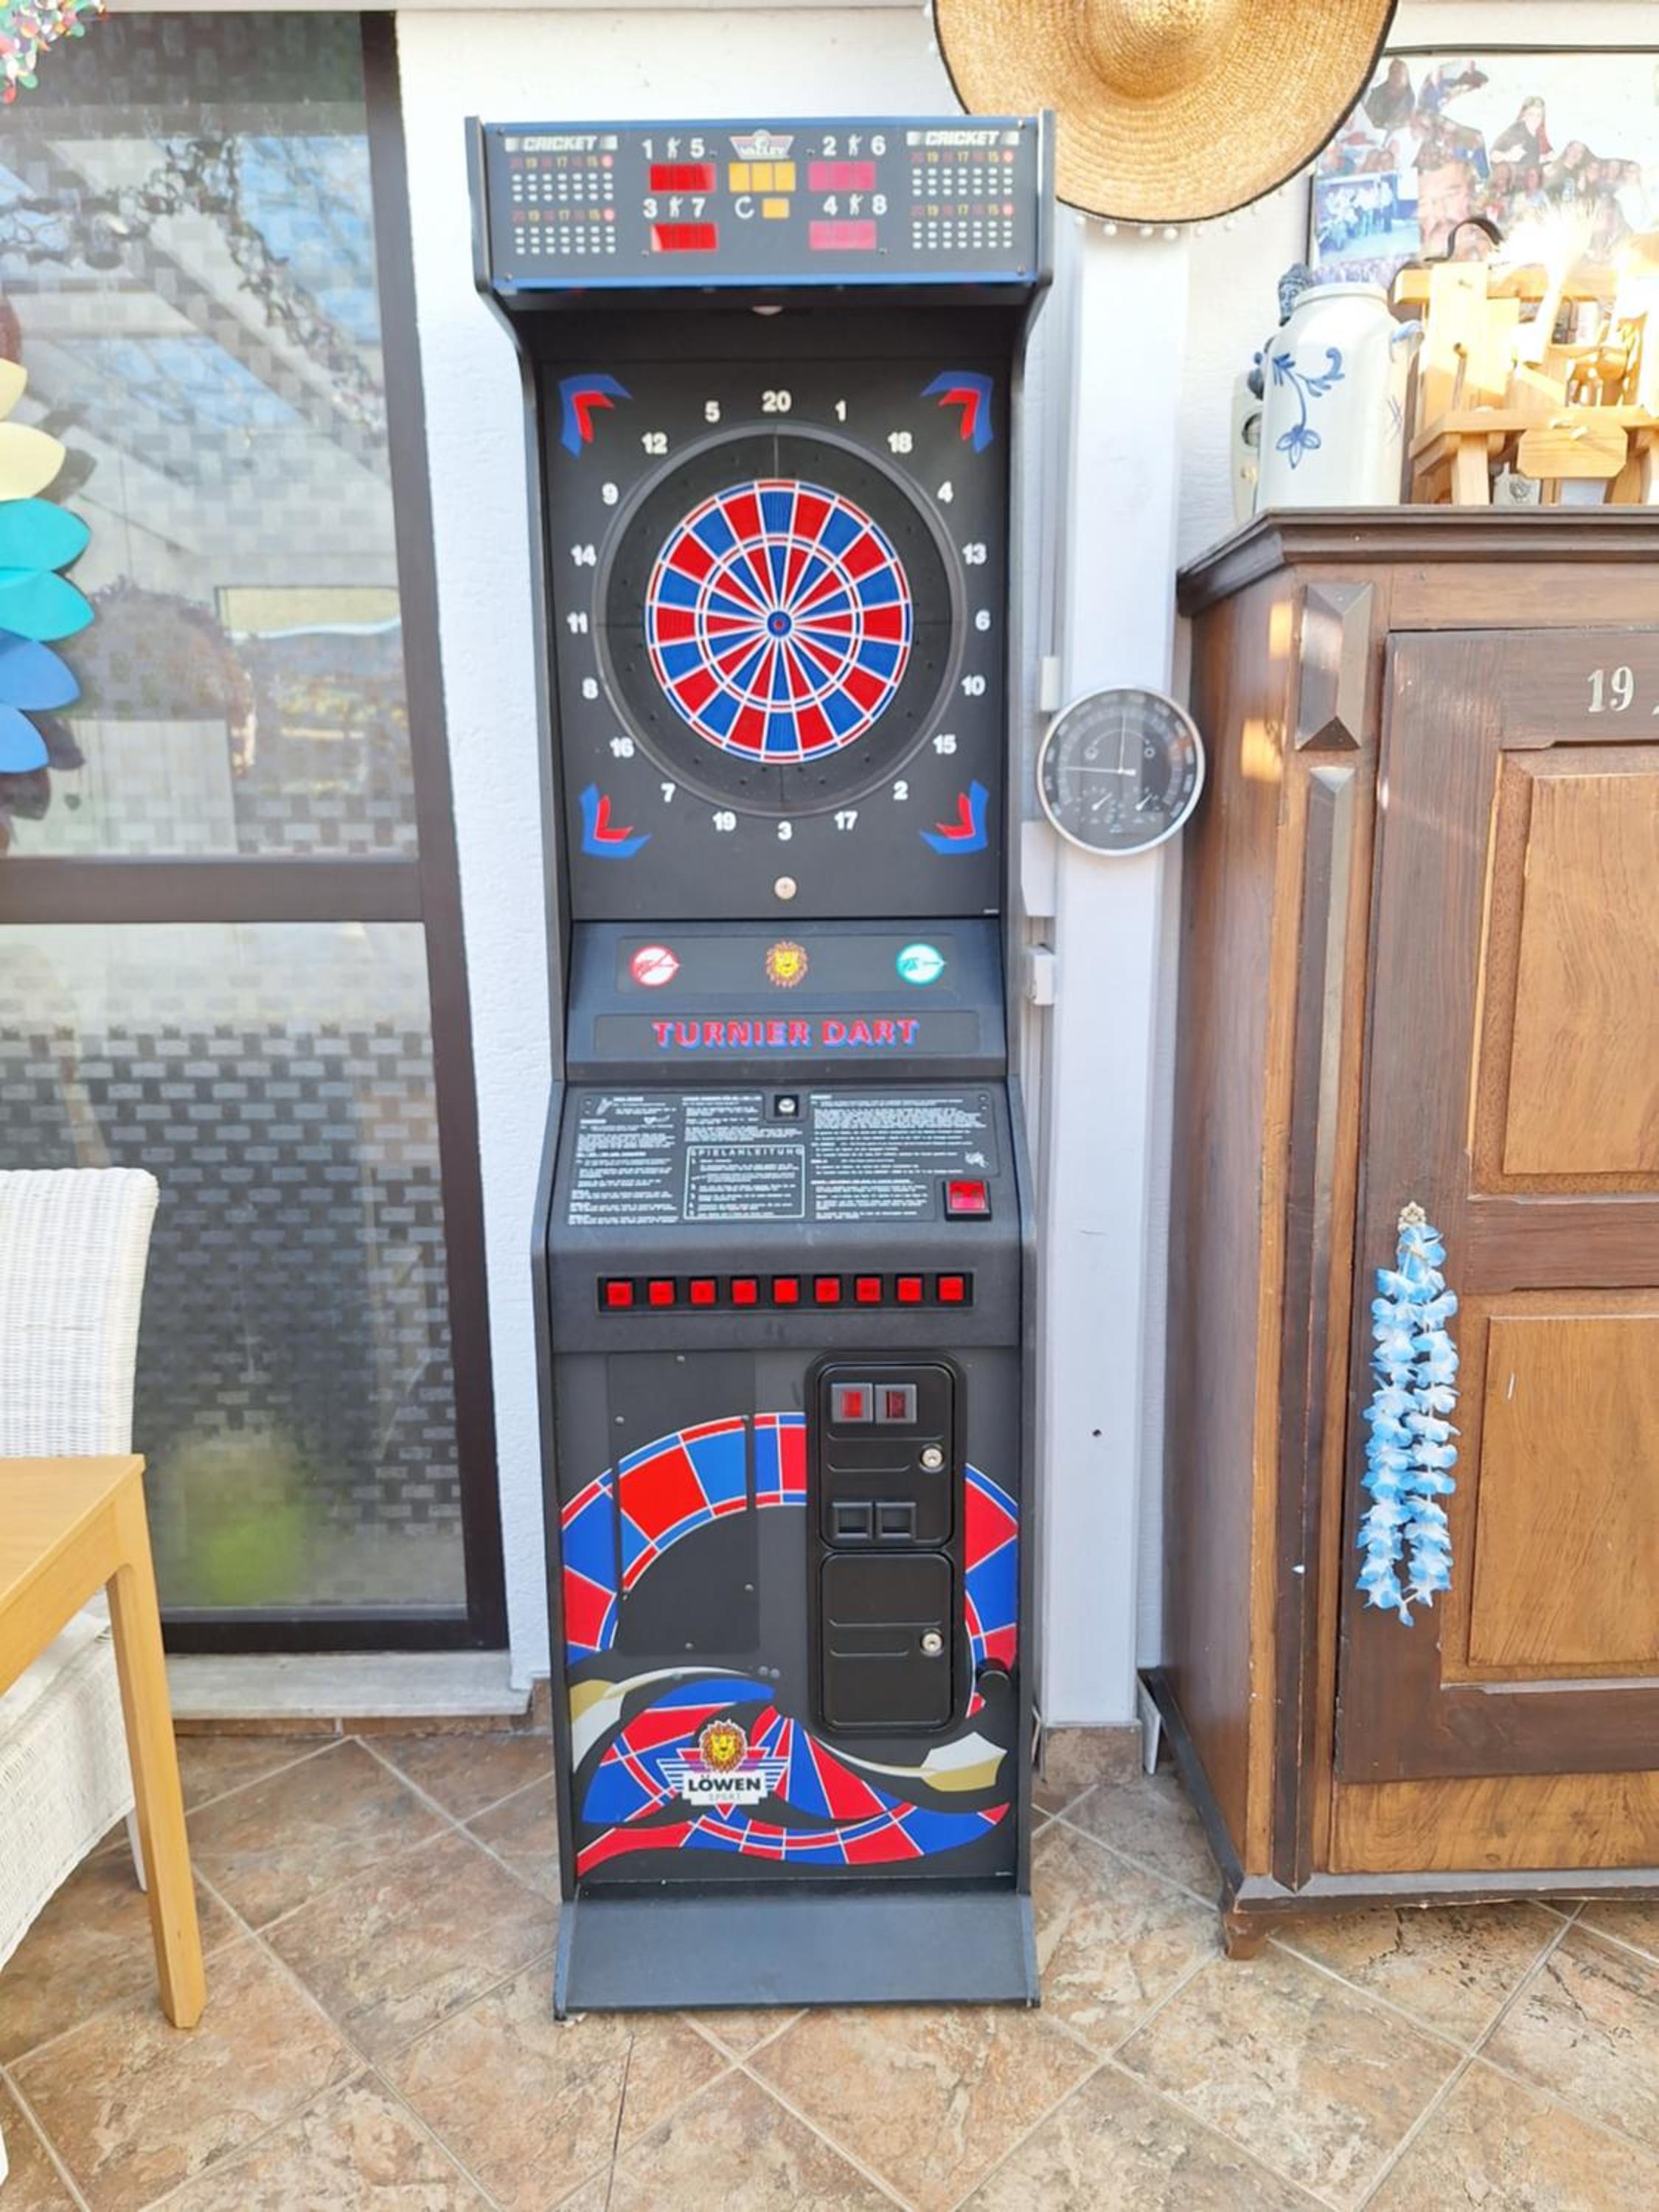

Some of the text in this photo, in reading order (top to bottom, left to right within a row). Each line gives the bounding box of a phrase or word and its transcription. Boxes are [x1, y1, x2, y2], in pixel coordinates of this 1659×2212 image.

[523, 135, 598, 152] CRICKET
[641, 137, 706, 160] 1 5
[822, 134, 887, 157] 2 6
[925, 130, 1000, 147] CRICKET
[642, 197, 707, 219] 3 7
[734, 195, 755, 220] C
[822, 195, 839, 216] 4
[872, 193, 888, 215] 8
[705, 400, 721, 423] 5
[762, 390, 792, 412] 20
[835, 400, 847, 422] 1
[641, 432, 668, 455] 12
[888, 431, 914, 454] 18
[602, 482, 619, 506] 9
[936, 481, 954, 504] 4
[571, 544, 597, 567] 14
[961, 543, 987, 565] 13
[567, 612, 588, 634] 11
[975, 610, 991, 631] 6
[582, 678, 599, 700] 8
[961, 675, 986, 696] 10
[1587, 667, 1635, 713] 19
[609, 737, 635, 758] 16
[932, 734, 957, 755] 15
[661, 782, 676, 803] 7
[893, 779, 909, 801] 2
[712, 811, 737, 832] 19
[777, 821, 793, 841] 3
[833, 810, 858, 830] 17
[653, 1019, 920, 1048] TURNIER DART
[689, 1775, 761, 1792] LÖWEN
